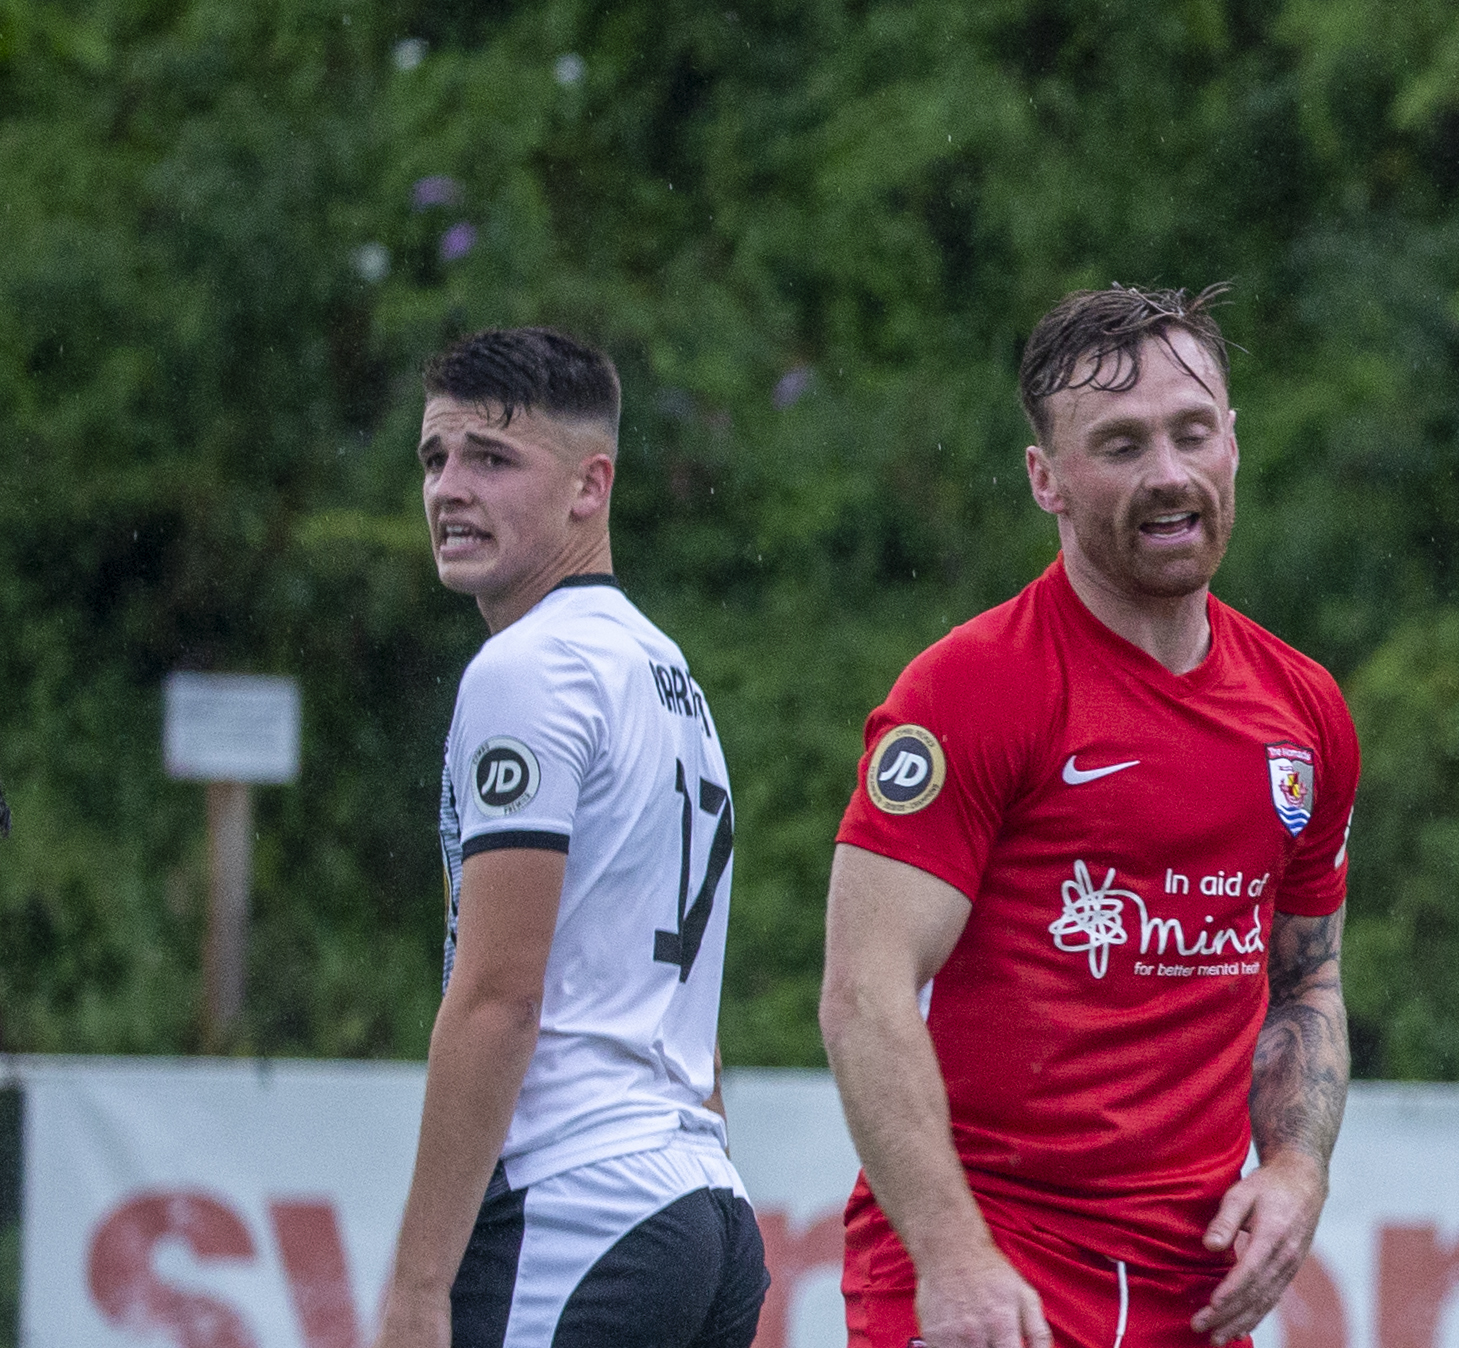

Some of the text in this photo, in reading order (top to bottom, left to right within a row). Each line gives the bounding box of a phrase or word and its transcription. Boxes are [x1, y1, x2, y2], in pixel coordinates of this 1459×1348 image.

[480, 759, 523, 796] JD
[878, 750, 929, 788] JD
[652, 757, 735, 984] 17
[1164, 868, 1190, 895] In
[1200, 870, 1243, 897] aid
[1133, 961, 1155, 976] for
[1156, 963, 1195, 977] better
[1197, 963, 1240, 976] mental
